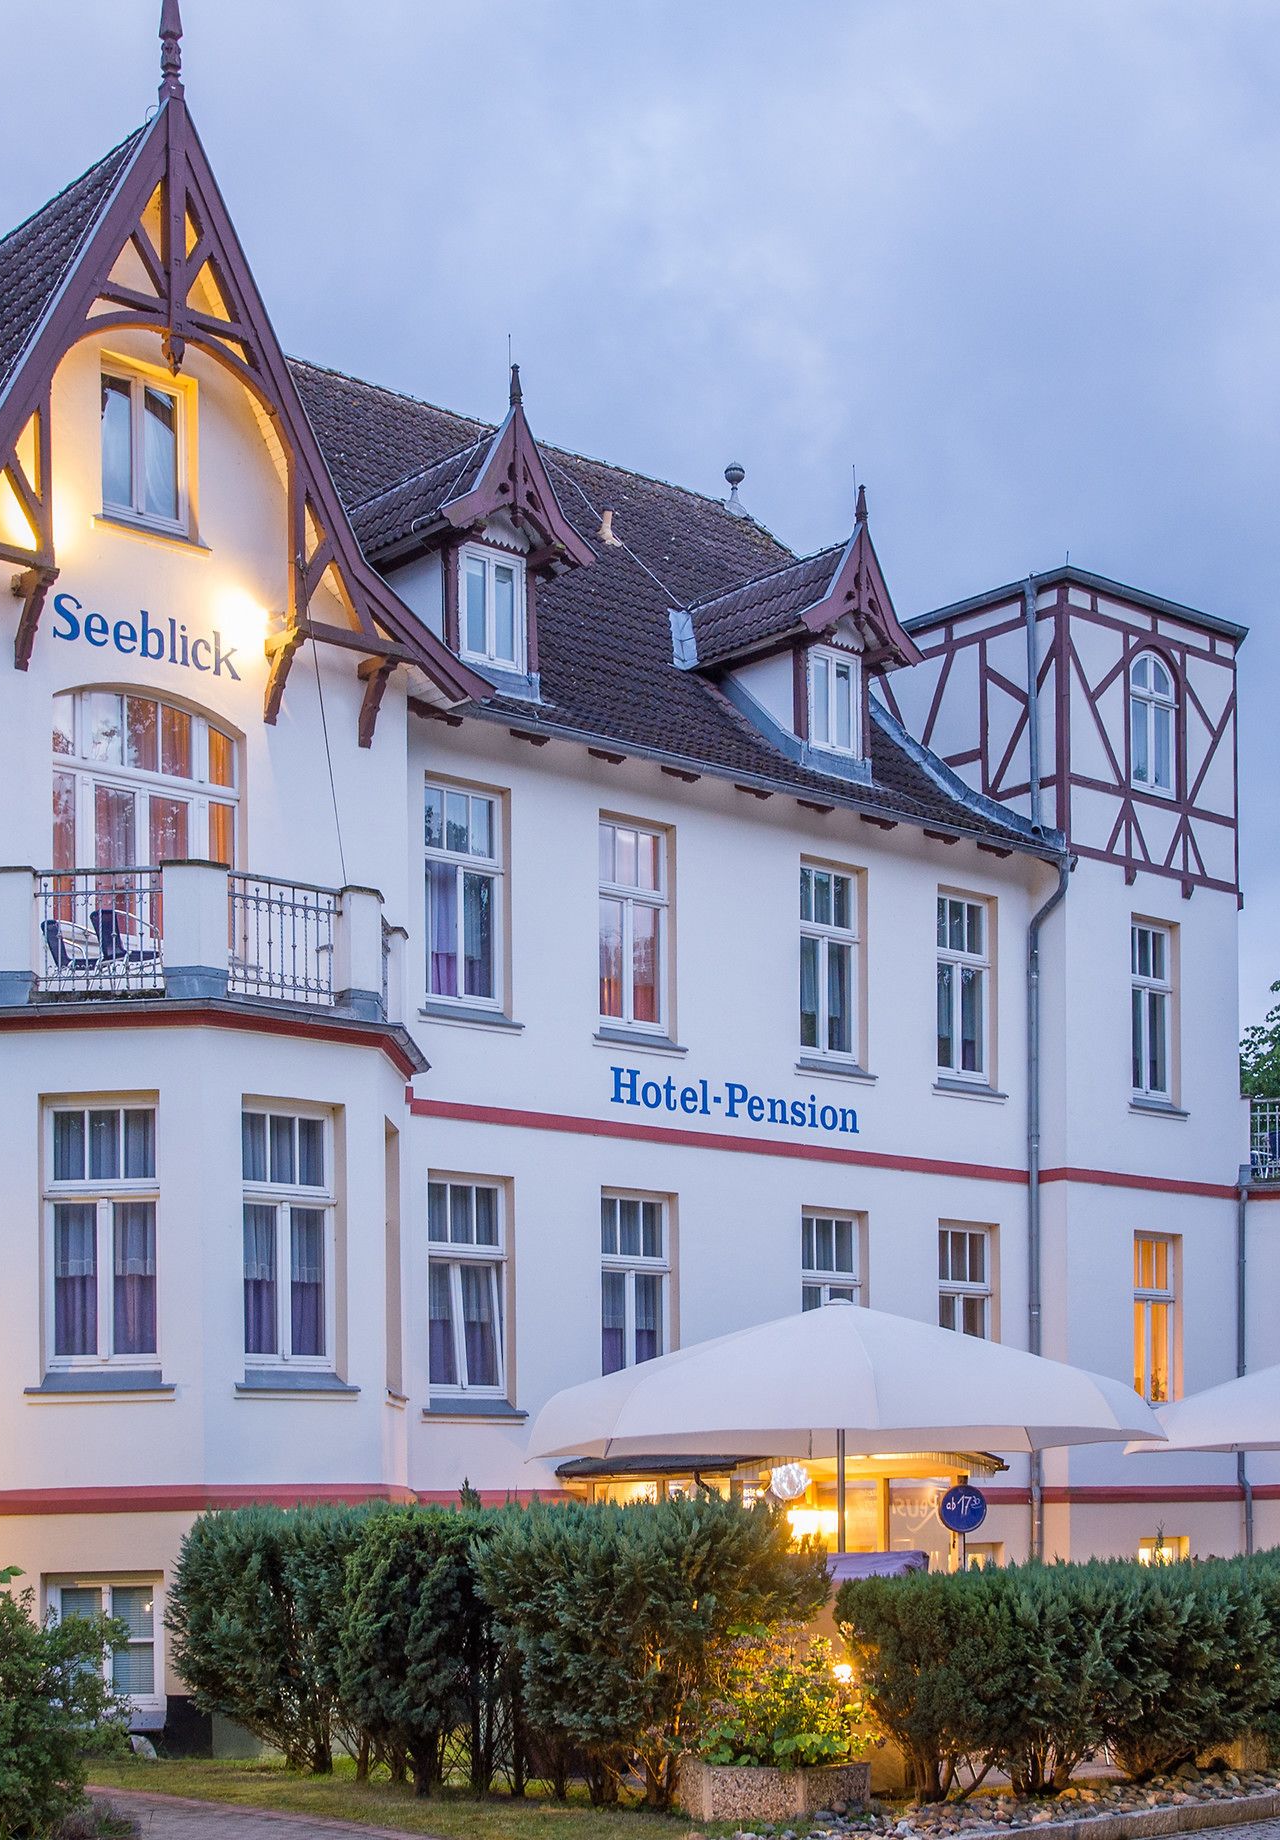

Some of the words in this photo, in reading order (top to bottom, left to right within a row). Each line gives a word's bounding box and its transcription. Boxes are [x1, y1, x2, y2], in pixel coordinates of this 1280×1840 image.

[52, 593, 242, 681] Seeblick
[609, 1065, 860, 1134] Hotel-Pension
[945, 1497, 957, 1511] ab
